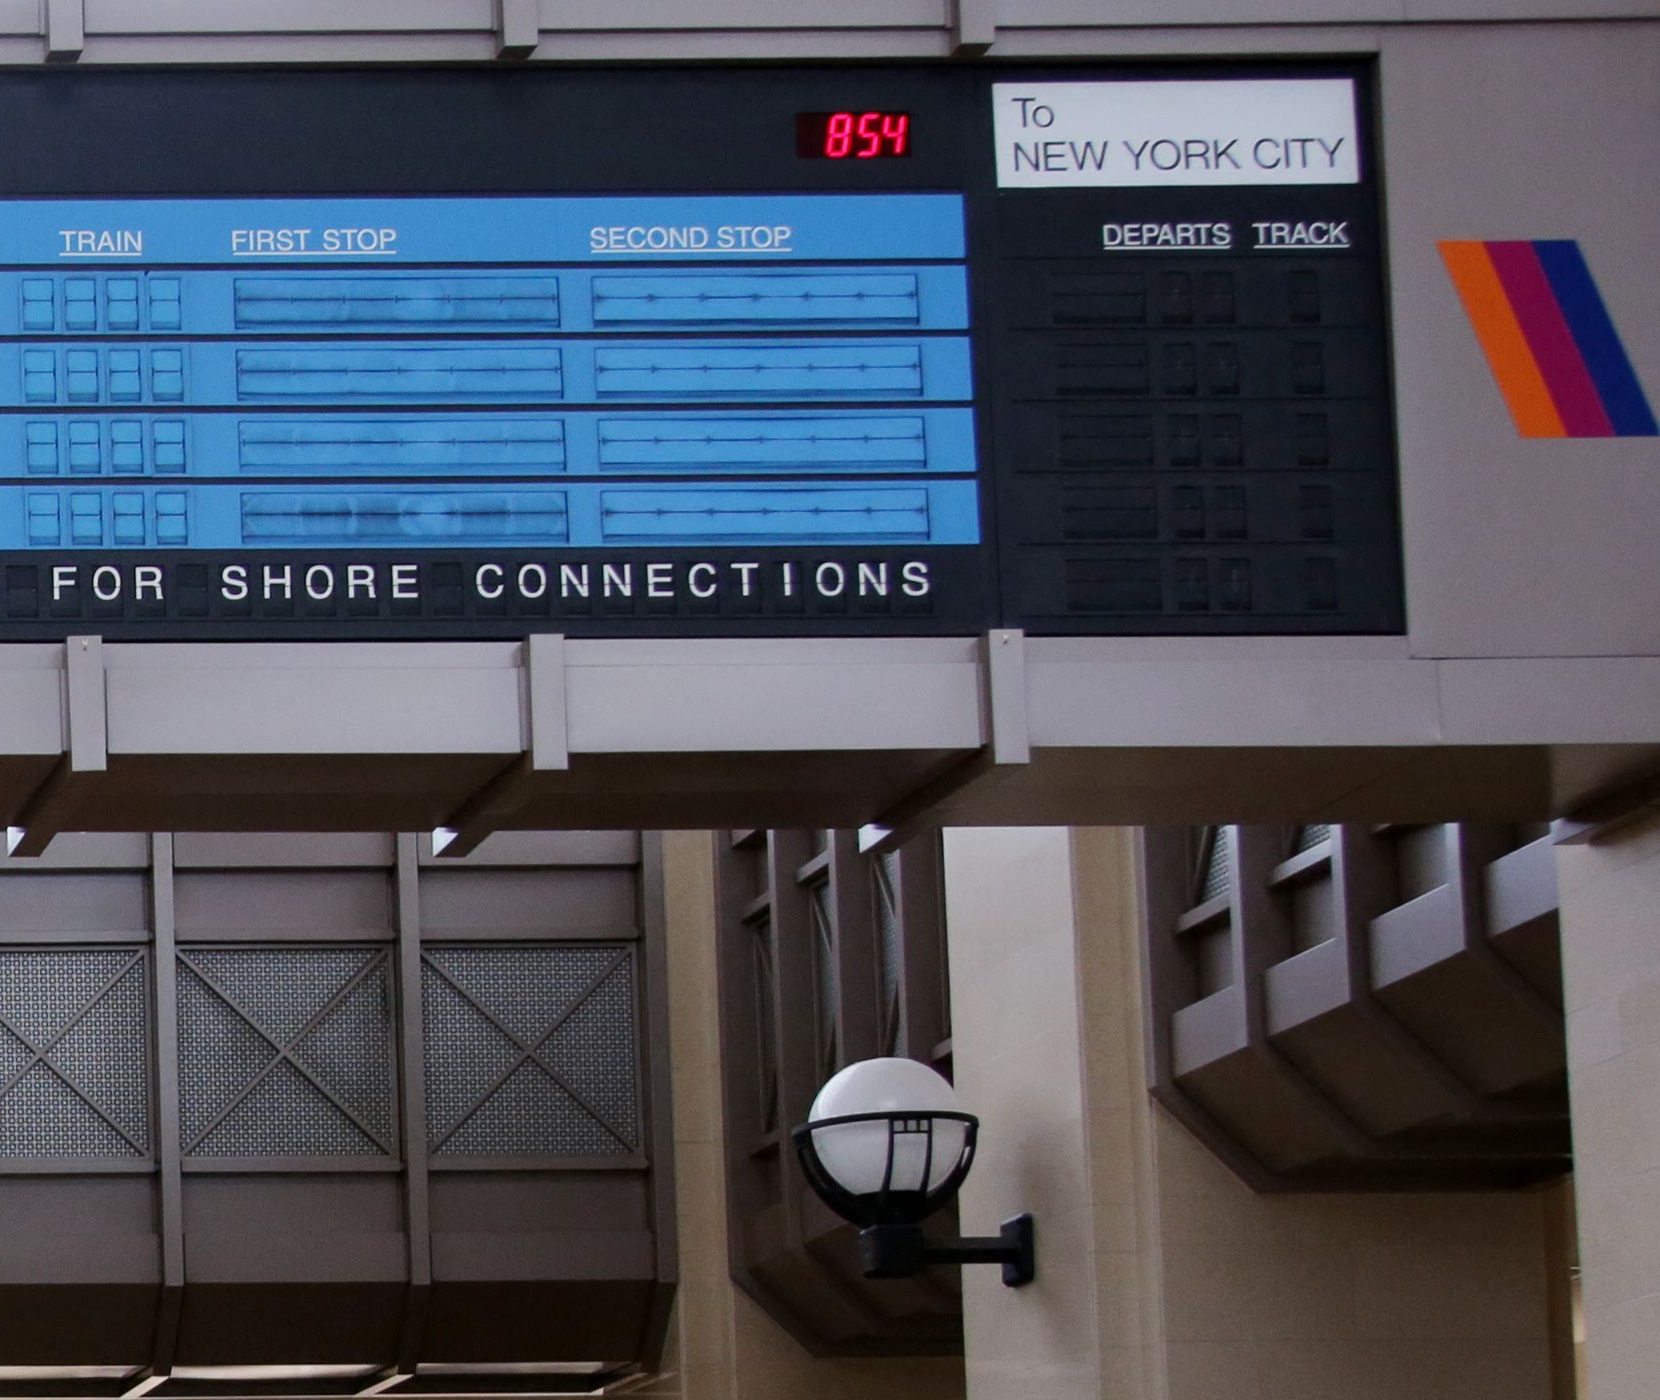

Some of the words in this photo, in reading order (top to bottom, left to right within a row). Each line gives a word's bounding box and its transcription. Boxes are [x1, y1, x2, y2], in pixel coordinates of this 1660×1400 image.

[1011, 97, 1056, 128] To
[1014, 141, 1108, 172] NEW
[1124, 139, 1240, 171] YORK
[1253, 137, 1345, 170] CITY
[59, 231, 143, 253] TRAIN
[231, 230, 311, 252] FIRST
[322, 229, 397, 251] STOP
[589, 227, 709, 250] SECOND
[716, 226, 792, 249] STOP
[1102, 223, 1231, 246] DEPARTS
[1251, 222, 1350, 245] TRACK
[53, 566, 164, 601] FOR
[221, 564, 419, 600] SHORE
[476, 561, 930, 599] CONNECTIONS
